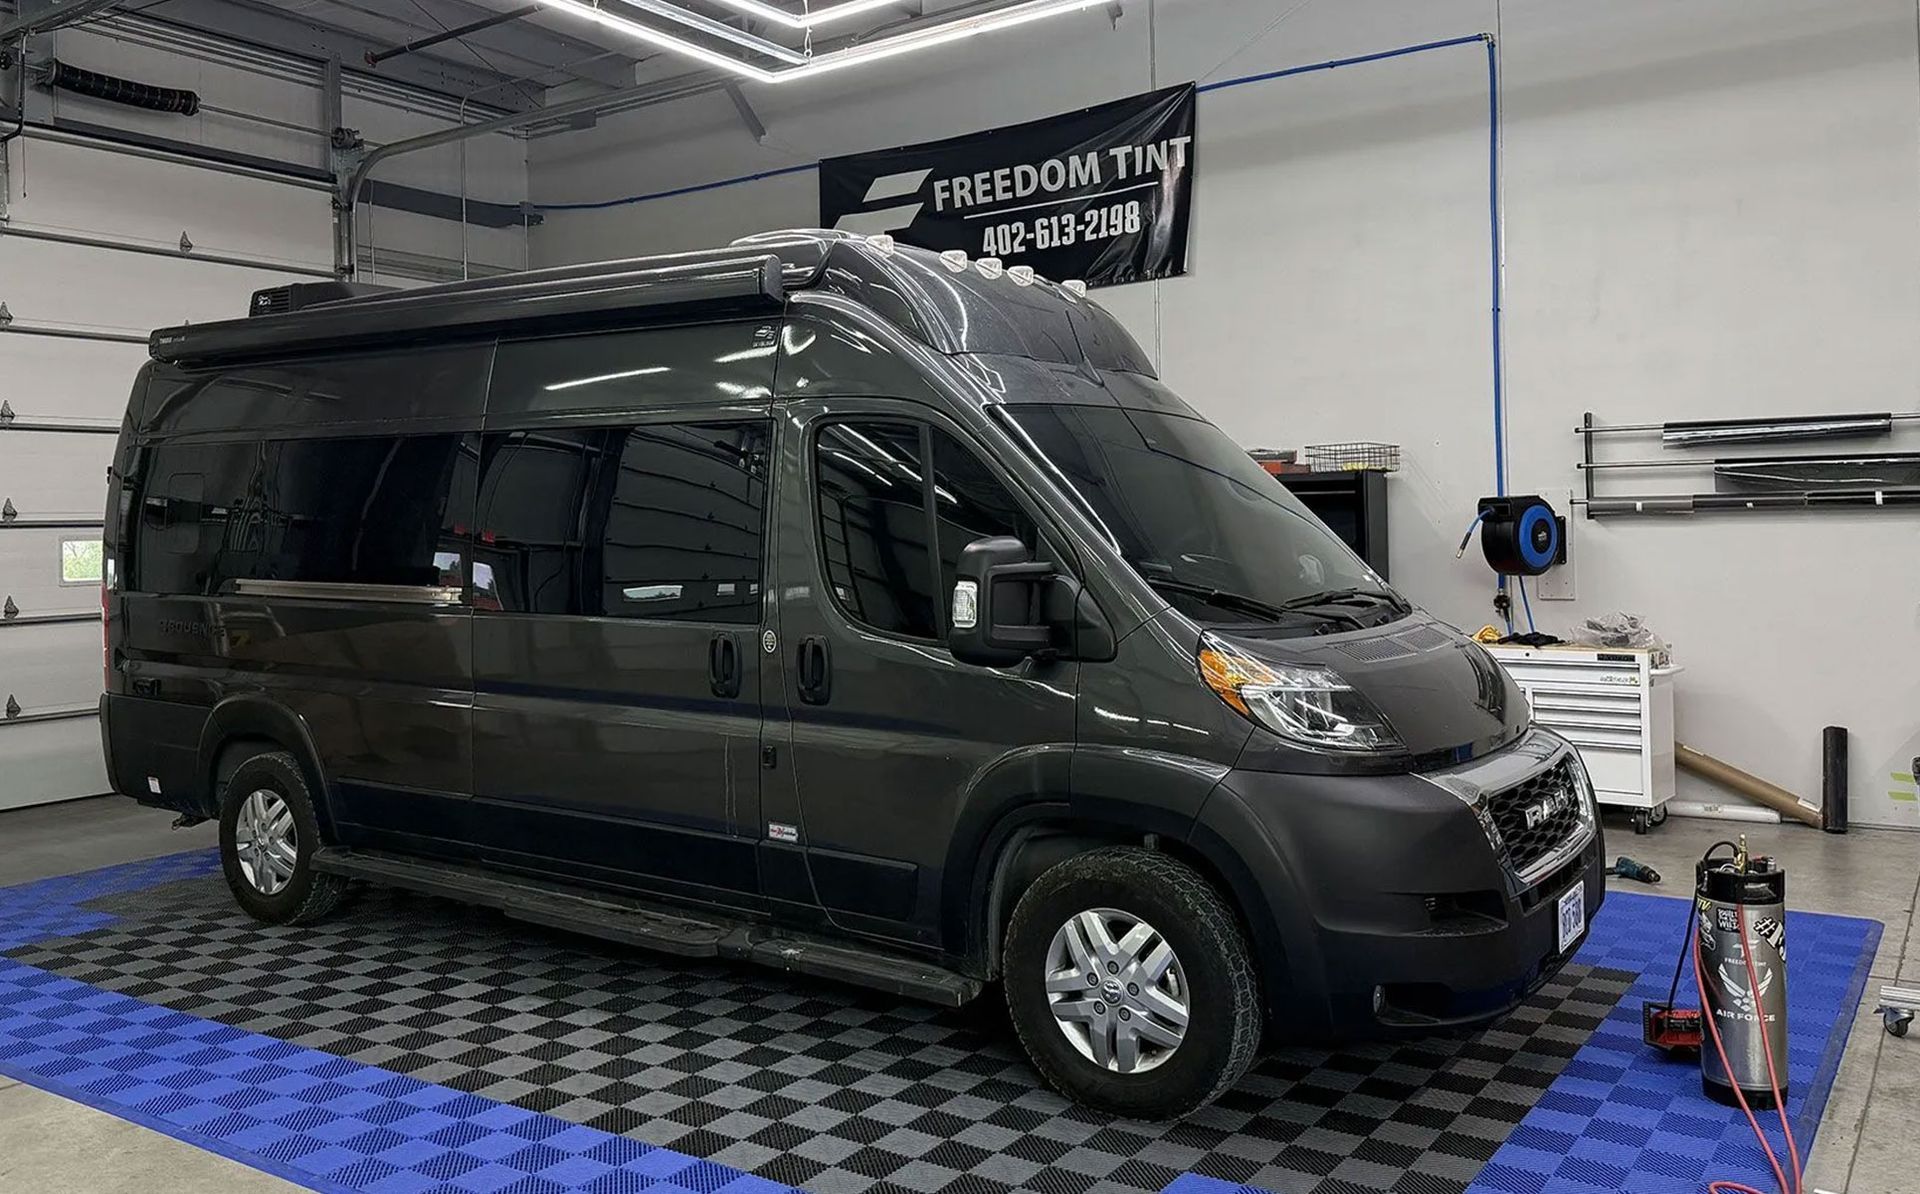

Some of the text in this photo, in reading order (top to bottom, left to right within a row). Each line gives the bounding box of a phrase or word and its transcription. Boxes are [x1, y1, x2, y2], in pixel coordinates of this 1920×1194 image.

[933, 136, 1191, 212] FREEDOM TINT
[982, 200, 1141, 257] 402-613-2198
[1525, 787, 1568, 830] RAM
[1724, 957, 1749, 966] FREEDO
[1716, 1009, 1735, 1019] AIR
